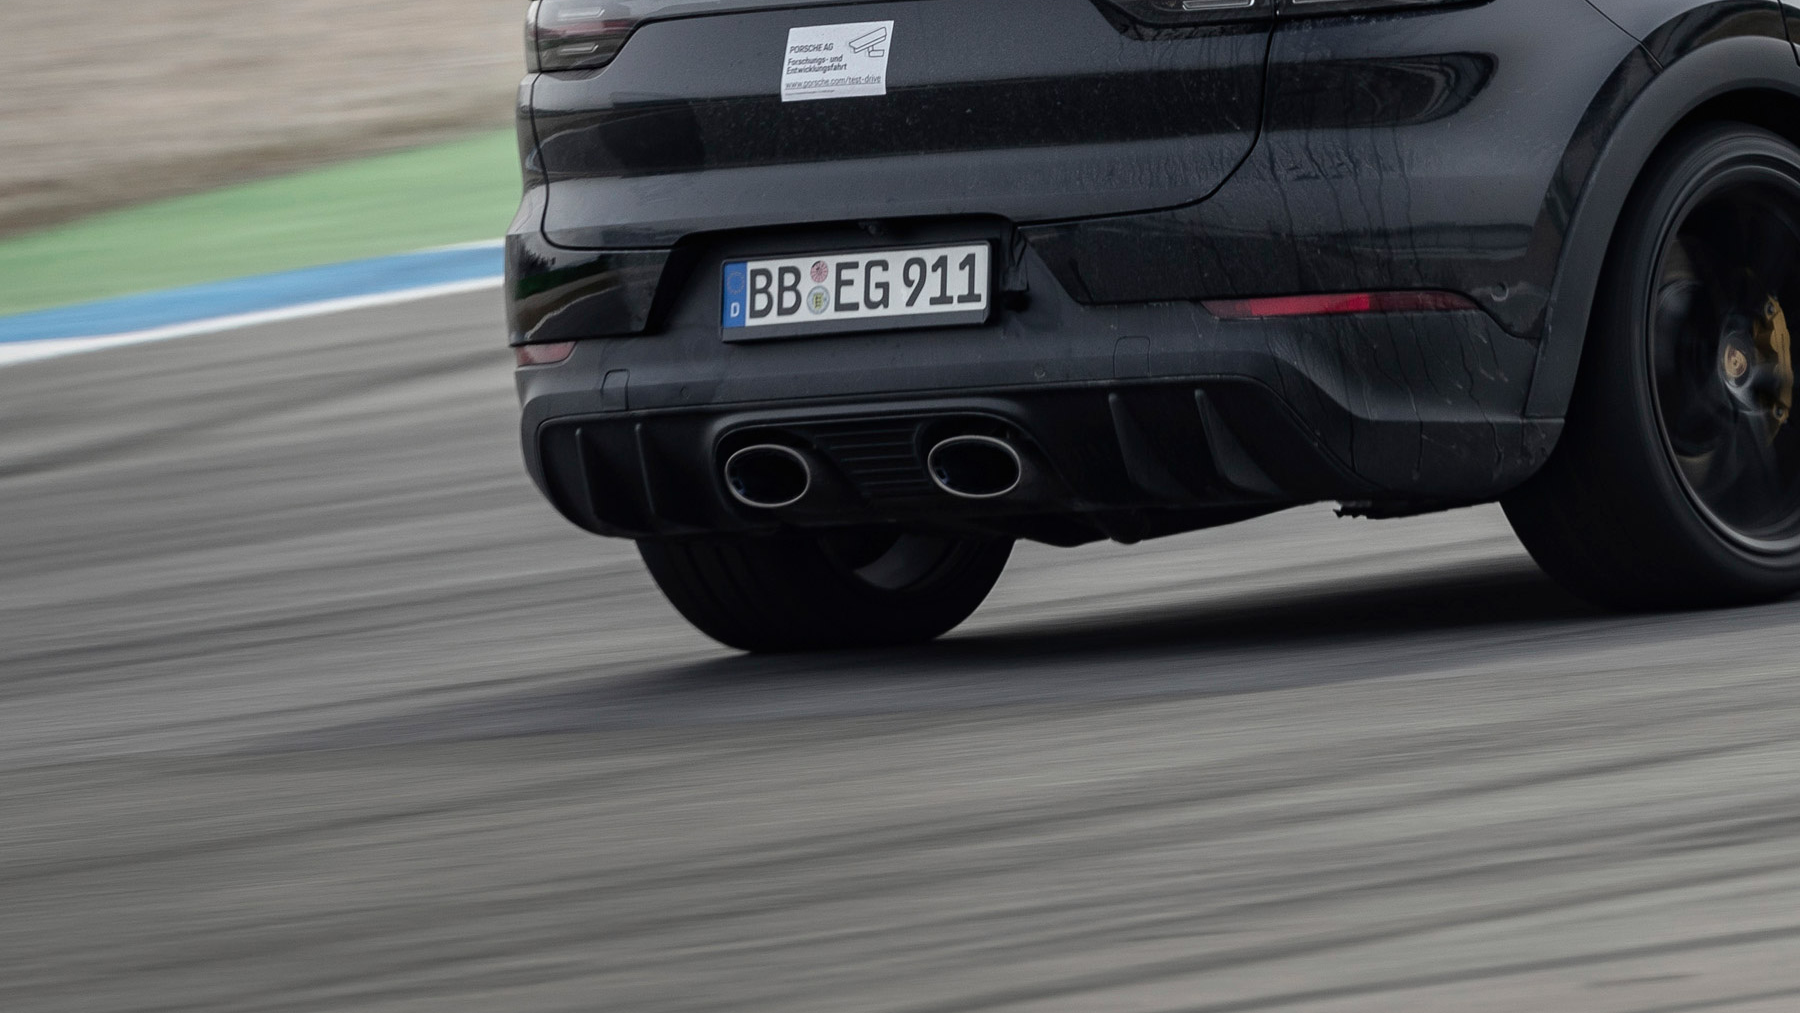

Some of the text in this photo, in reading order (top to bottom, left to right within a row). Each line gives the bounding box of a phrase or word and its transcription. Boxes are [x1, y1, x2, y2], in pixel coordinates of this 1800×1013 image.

[789, 43, 834, 54] PORSCHE AG
[788, 54, 843, 66] Forschungs- und
[786, 63, 848, 74] Entwicklungsfahrt
[785, 74, 881, 89] www.porsche.com/test-drive
[749, 252, 982, 319] BB EG 911
[730, 301, 740, 318] D
